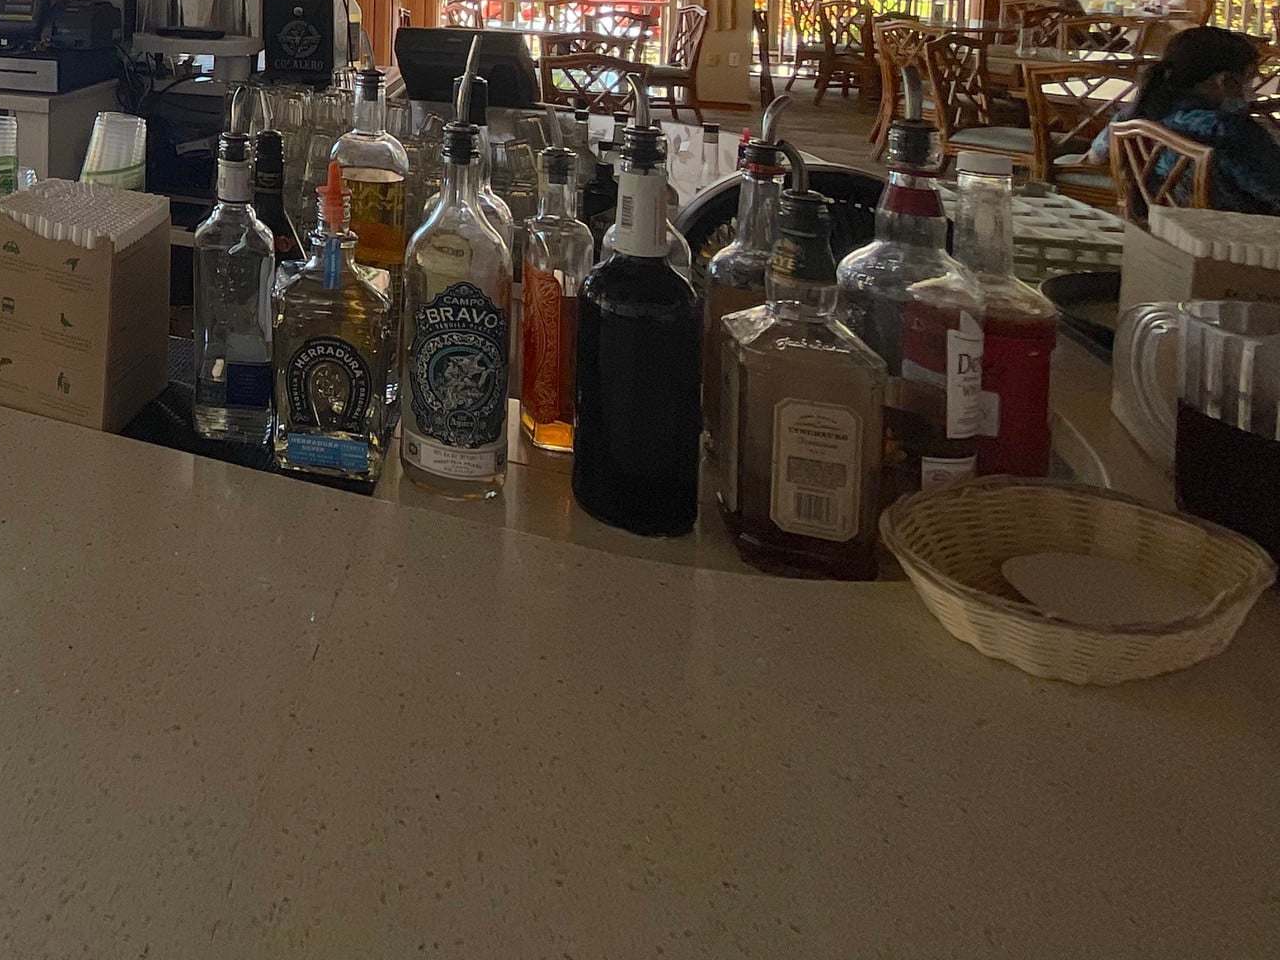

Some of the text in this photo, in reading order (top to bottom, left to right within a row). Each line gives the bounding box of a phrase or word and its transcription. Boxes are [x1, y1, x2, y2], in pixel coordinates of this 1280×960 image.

[443, 296, 485, 307] CAMPO
[426, 307, 498, 328] BRAVO
[294, 345, 364, 378] HERRADURA
[290, 437, 339, 449] HERRADURA
